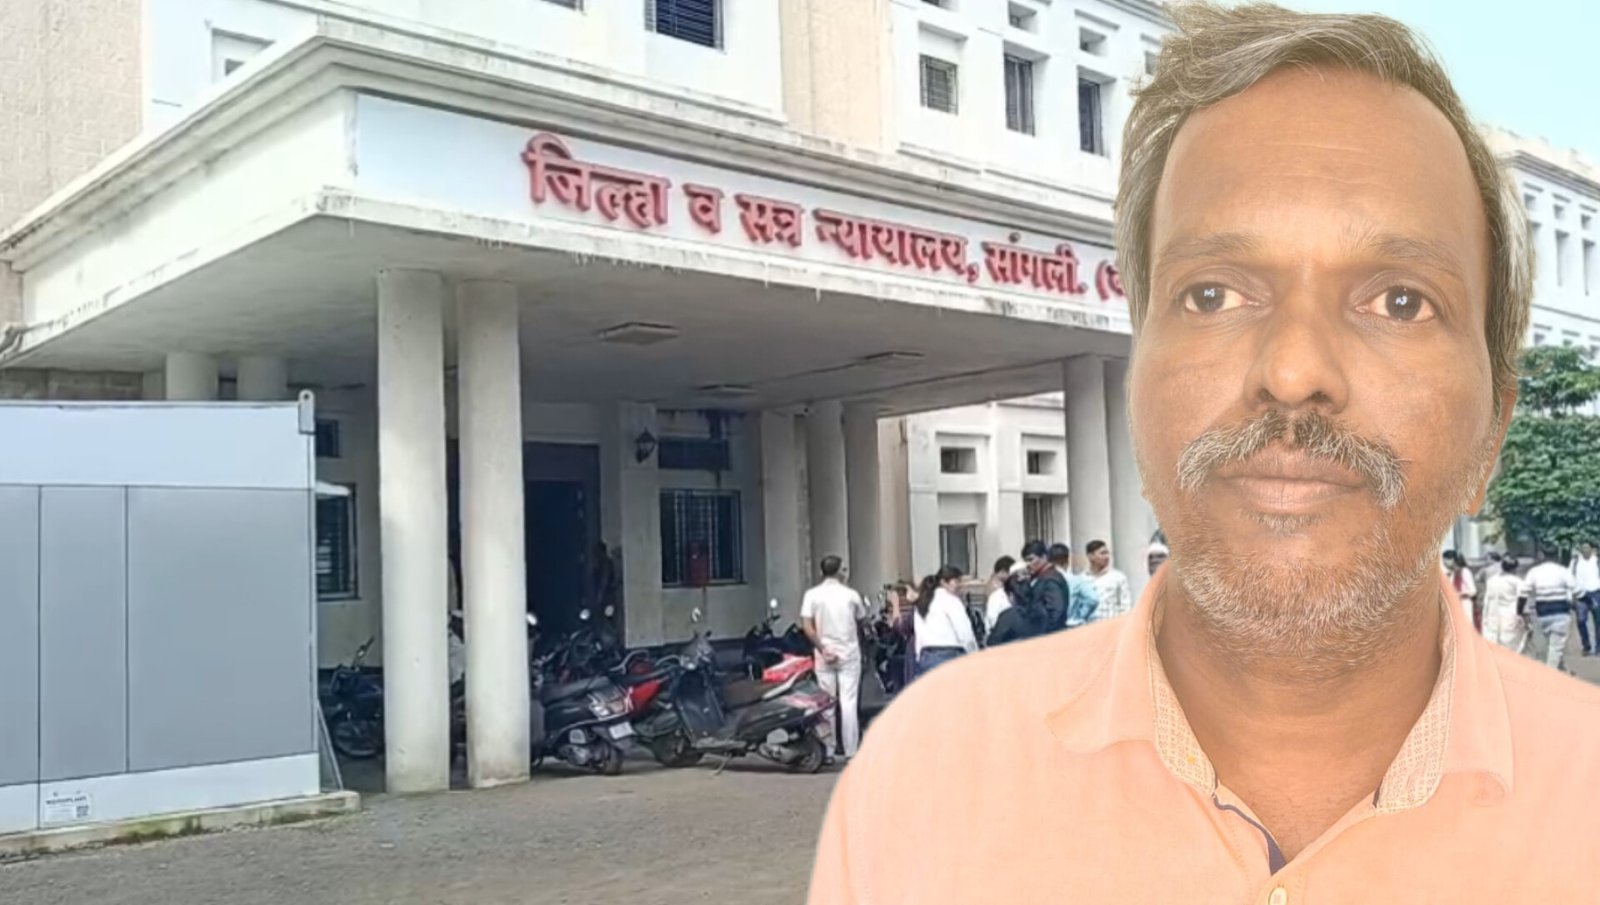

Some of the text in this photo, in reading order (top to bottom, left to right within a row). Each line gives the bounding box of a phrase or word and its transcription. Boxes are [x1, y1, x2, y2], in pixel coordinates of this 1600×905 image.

[521, 133, 671, 228] जिल्हा
[683, 183, 724, 233] व
[734, 193, 804, 247] सत्र
[811, 208, 979, 283] न्यायालय,
[980, 232, 1088, 294] सांगली.
